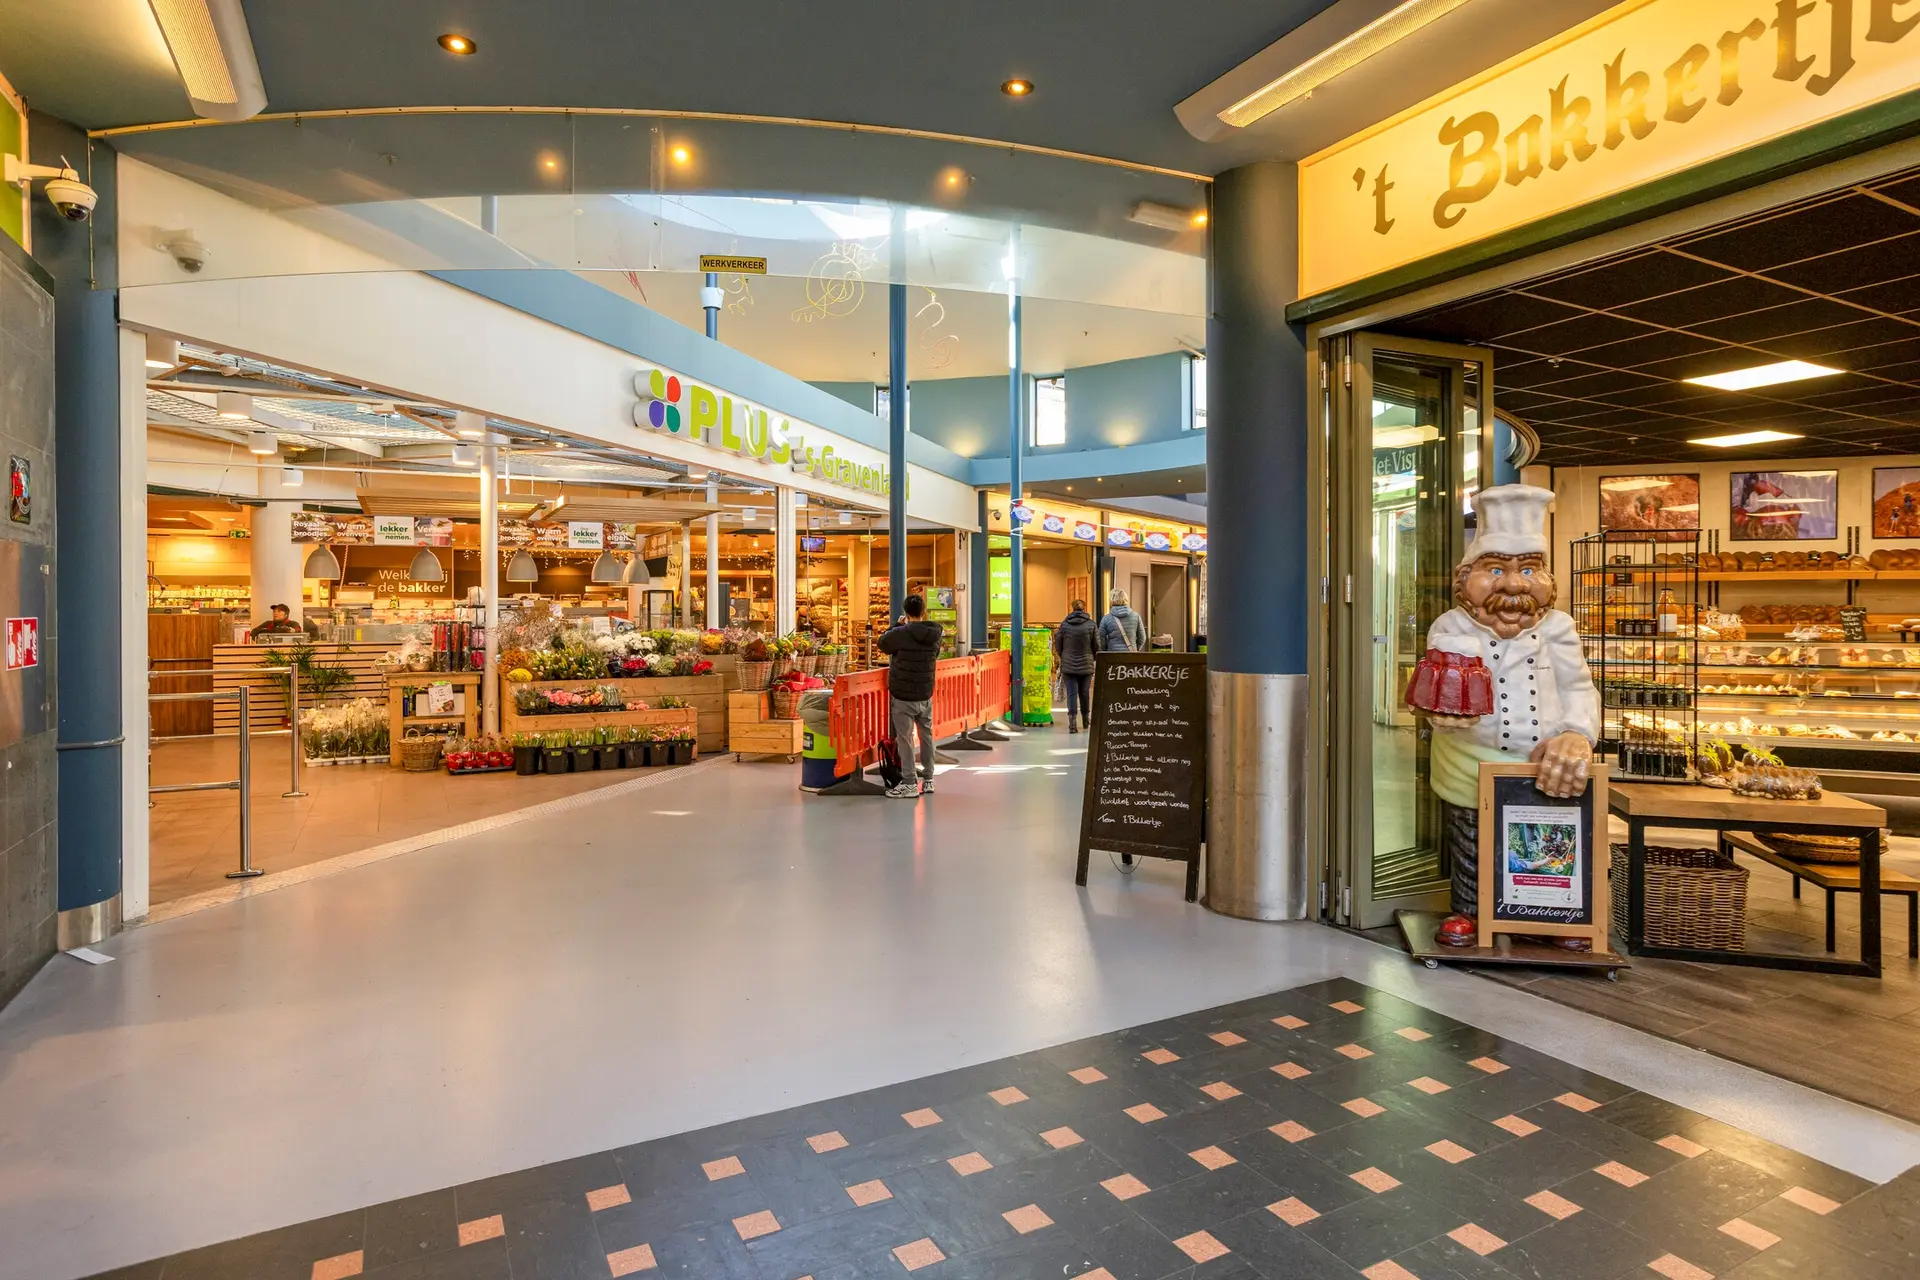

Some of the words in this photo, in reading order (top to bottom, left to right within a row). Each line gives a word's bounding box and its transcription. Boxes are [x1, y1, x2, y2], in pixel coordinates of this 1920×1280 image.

[1353, 164, 1396, 236] 't
[702, 259, 765, 270] WERKVERKEER
[690, 384, 790, 464] PLUS
[799, 436, 910, 501] 's-Gravenla
[336, 522, 366, 530] Warm
[380, 525, 408, 533] lekker
[378, 569, 410, 580] Welk
[378, 582, 394, 592] de
[398, 582, 446, 592] bakker
[1100, 786, 1110, 794] En
